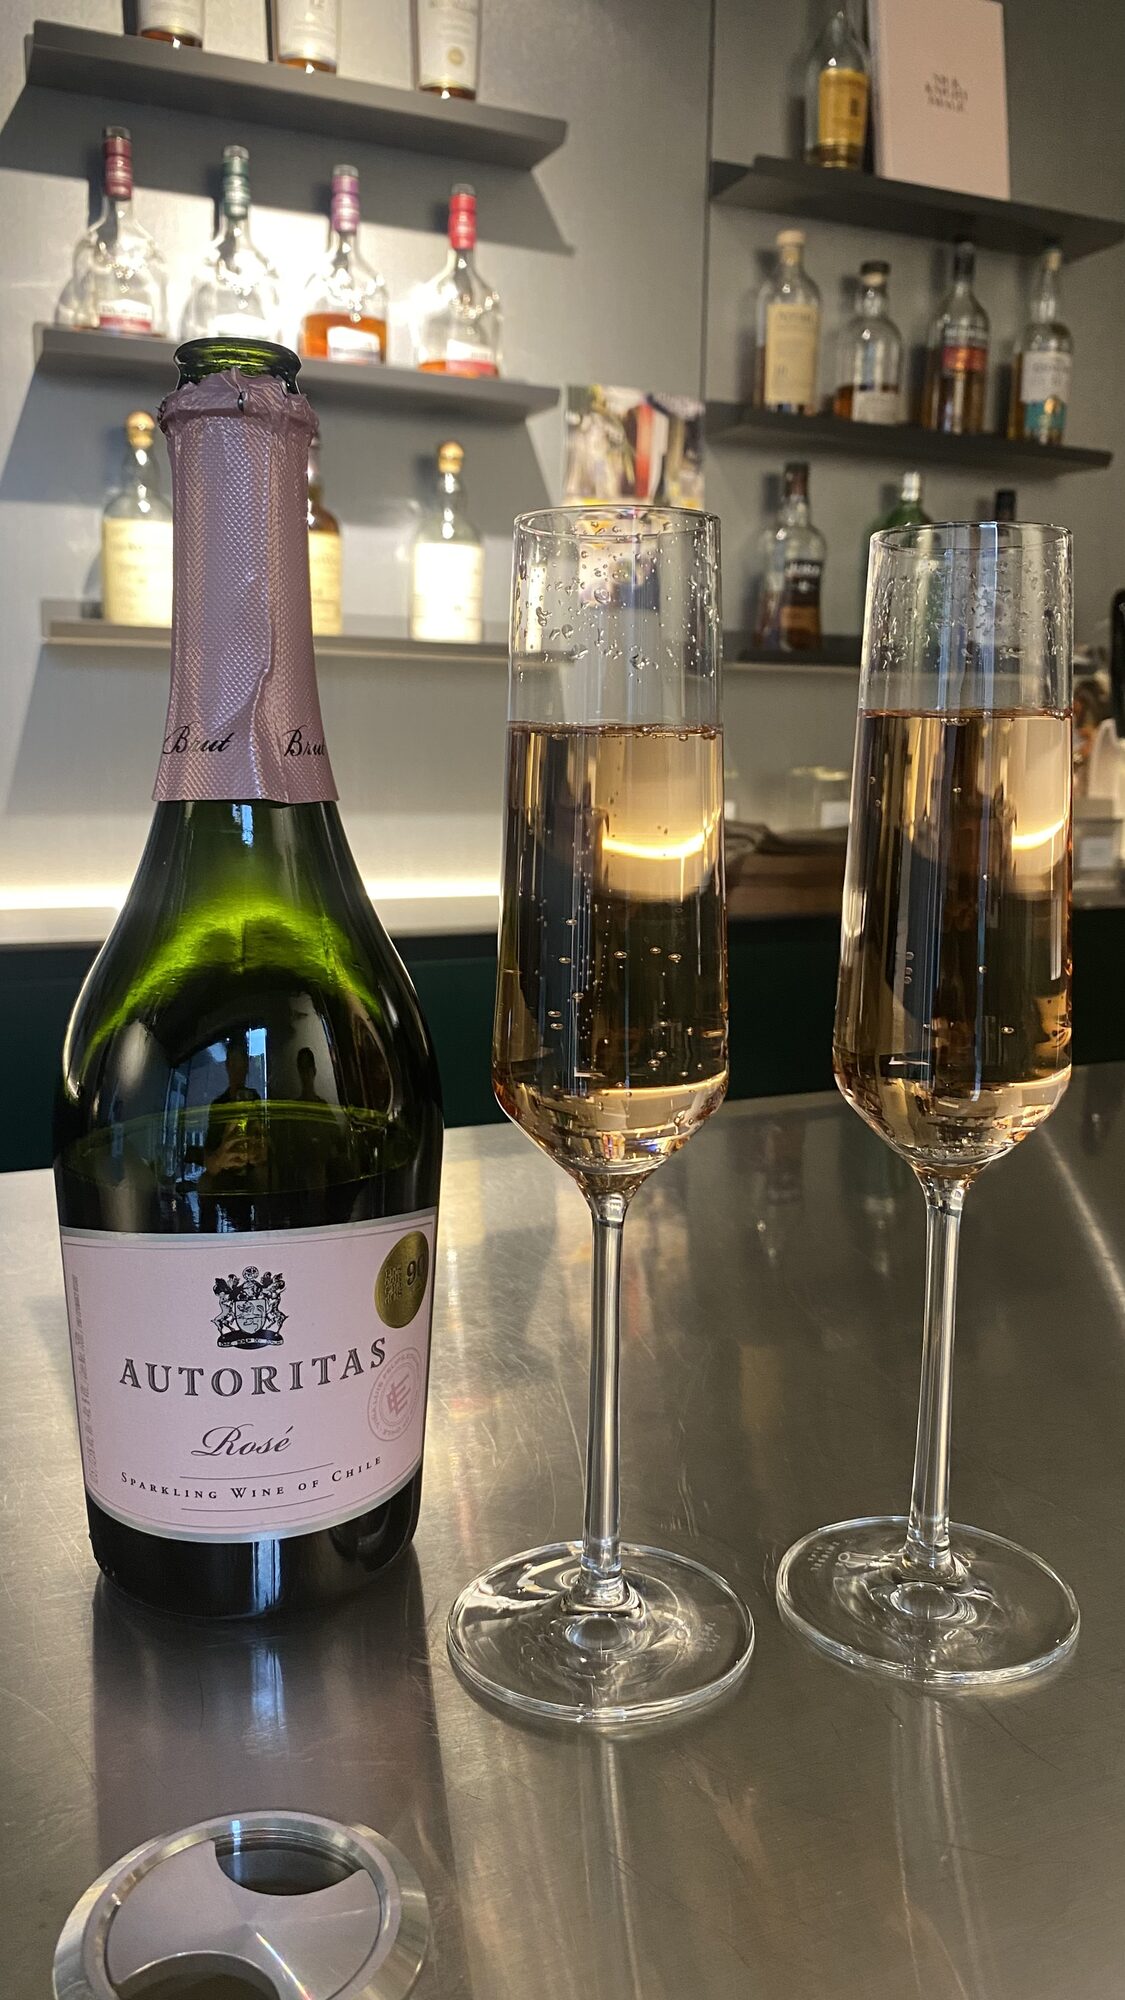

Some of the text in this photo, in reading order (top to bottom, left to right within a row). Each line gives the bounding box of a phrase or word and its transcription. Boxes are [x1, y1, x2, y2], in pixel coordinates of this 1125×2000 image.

[163, 722, 234, 754] Brut
[119, 1337, 387, 1397] AUTORITAS
[190, 1423, 294, 1457] Rosé
